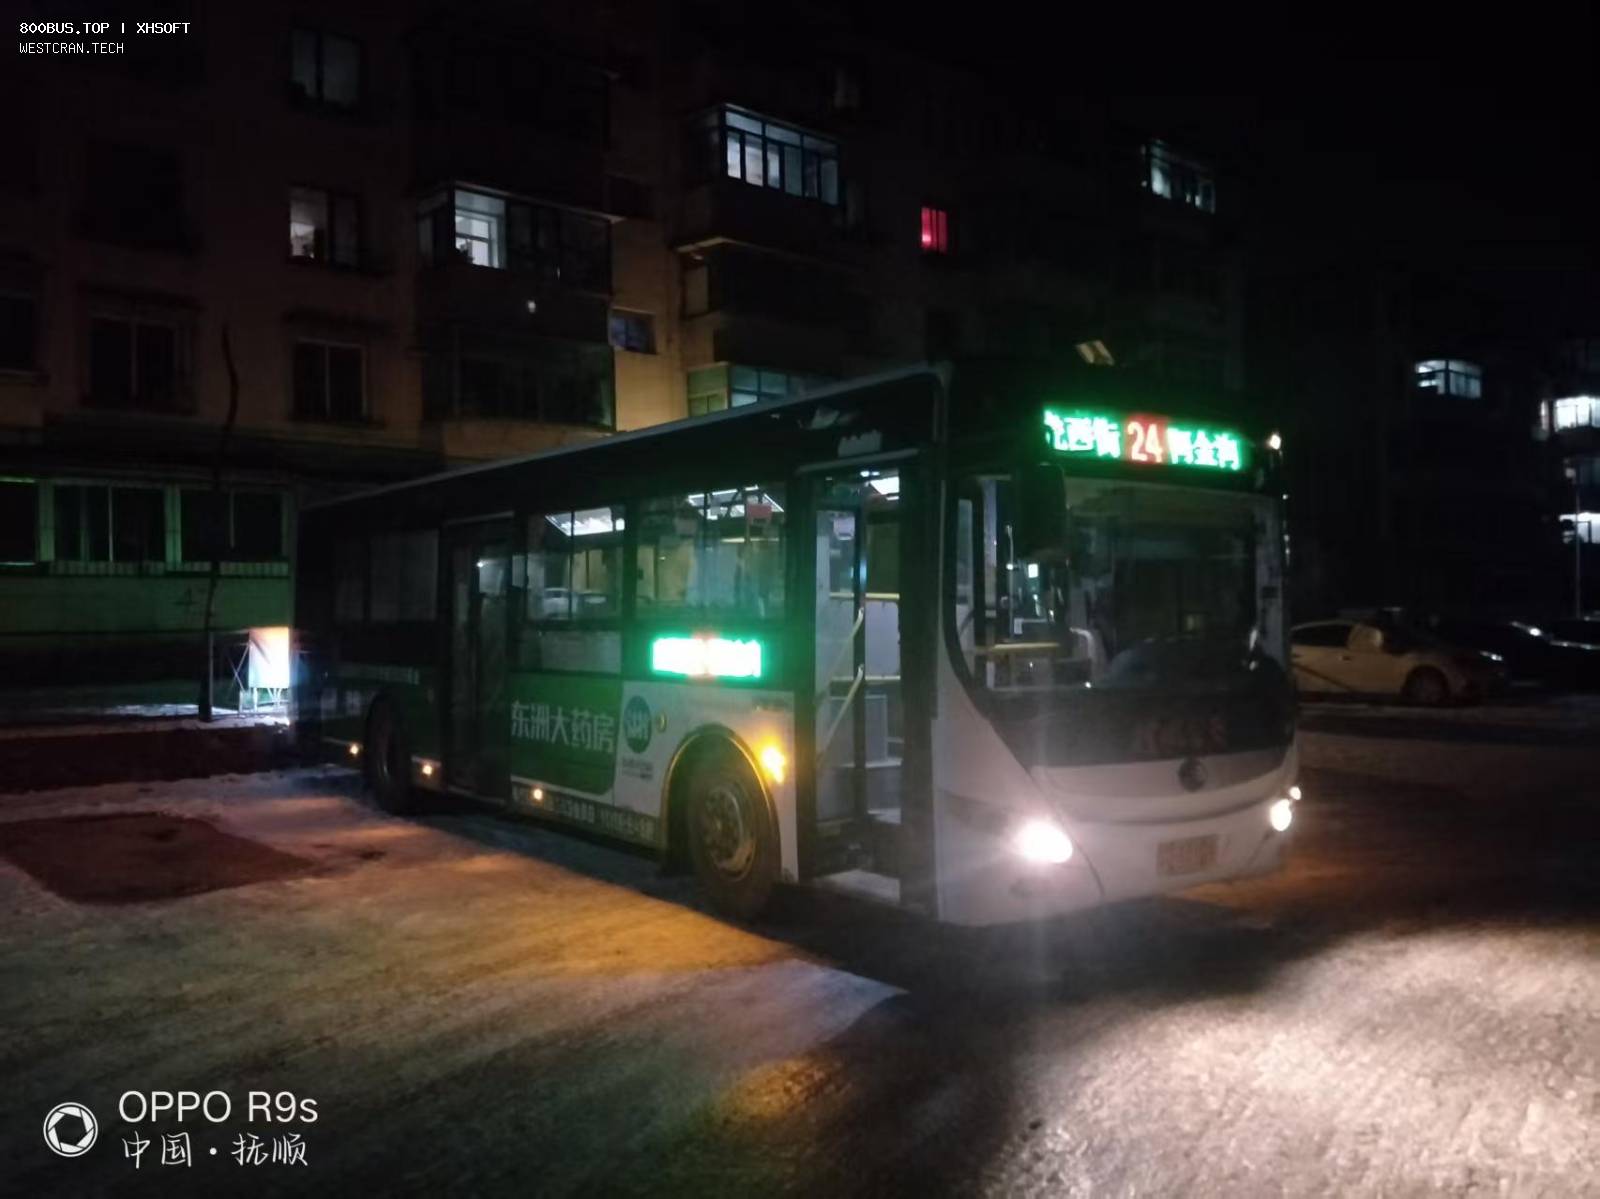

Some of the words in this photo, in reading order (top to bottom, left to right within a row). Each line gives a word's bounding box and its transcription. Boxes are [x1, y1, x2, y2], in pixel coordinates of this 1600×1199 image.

[1127, 421, 1163, 463] 24
[510, 699, 615, 754] 东洲大药房
